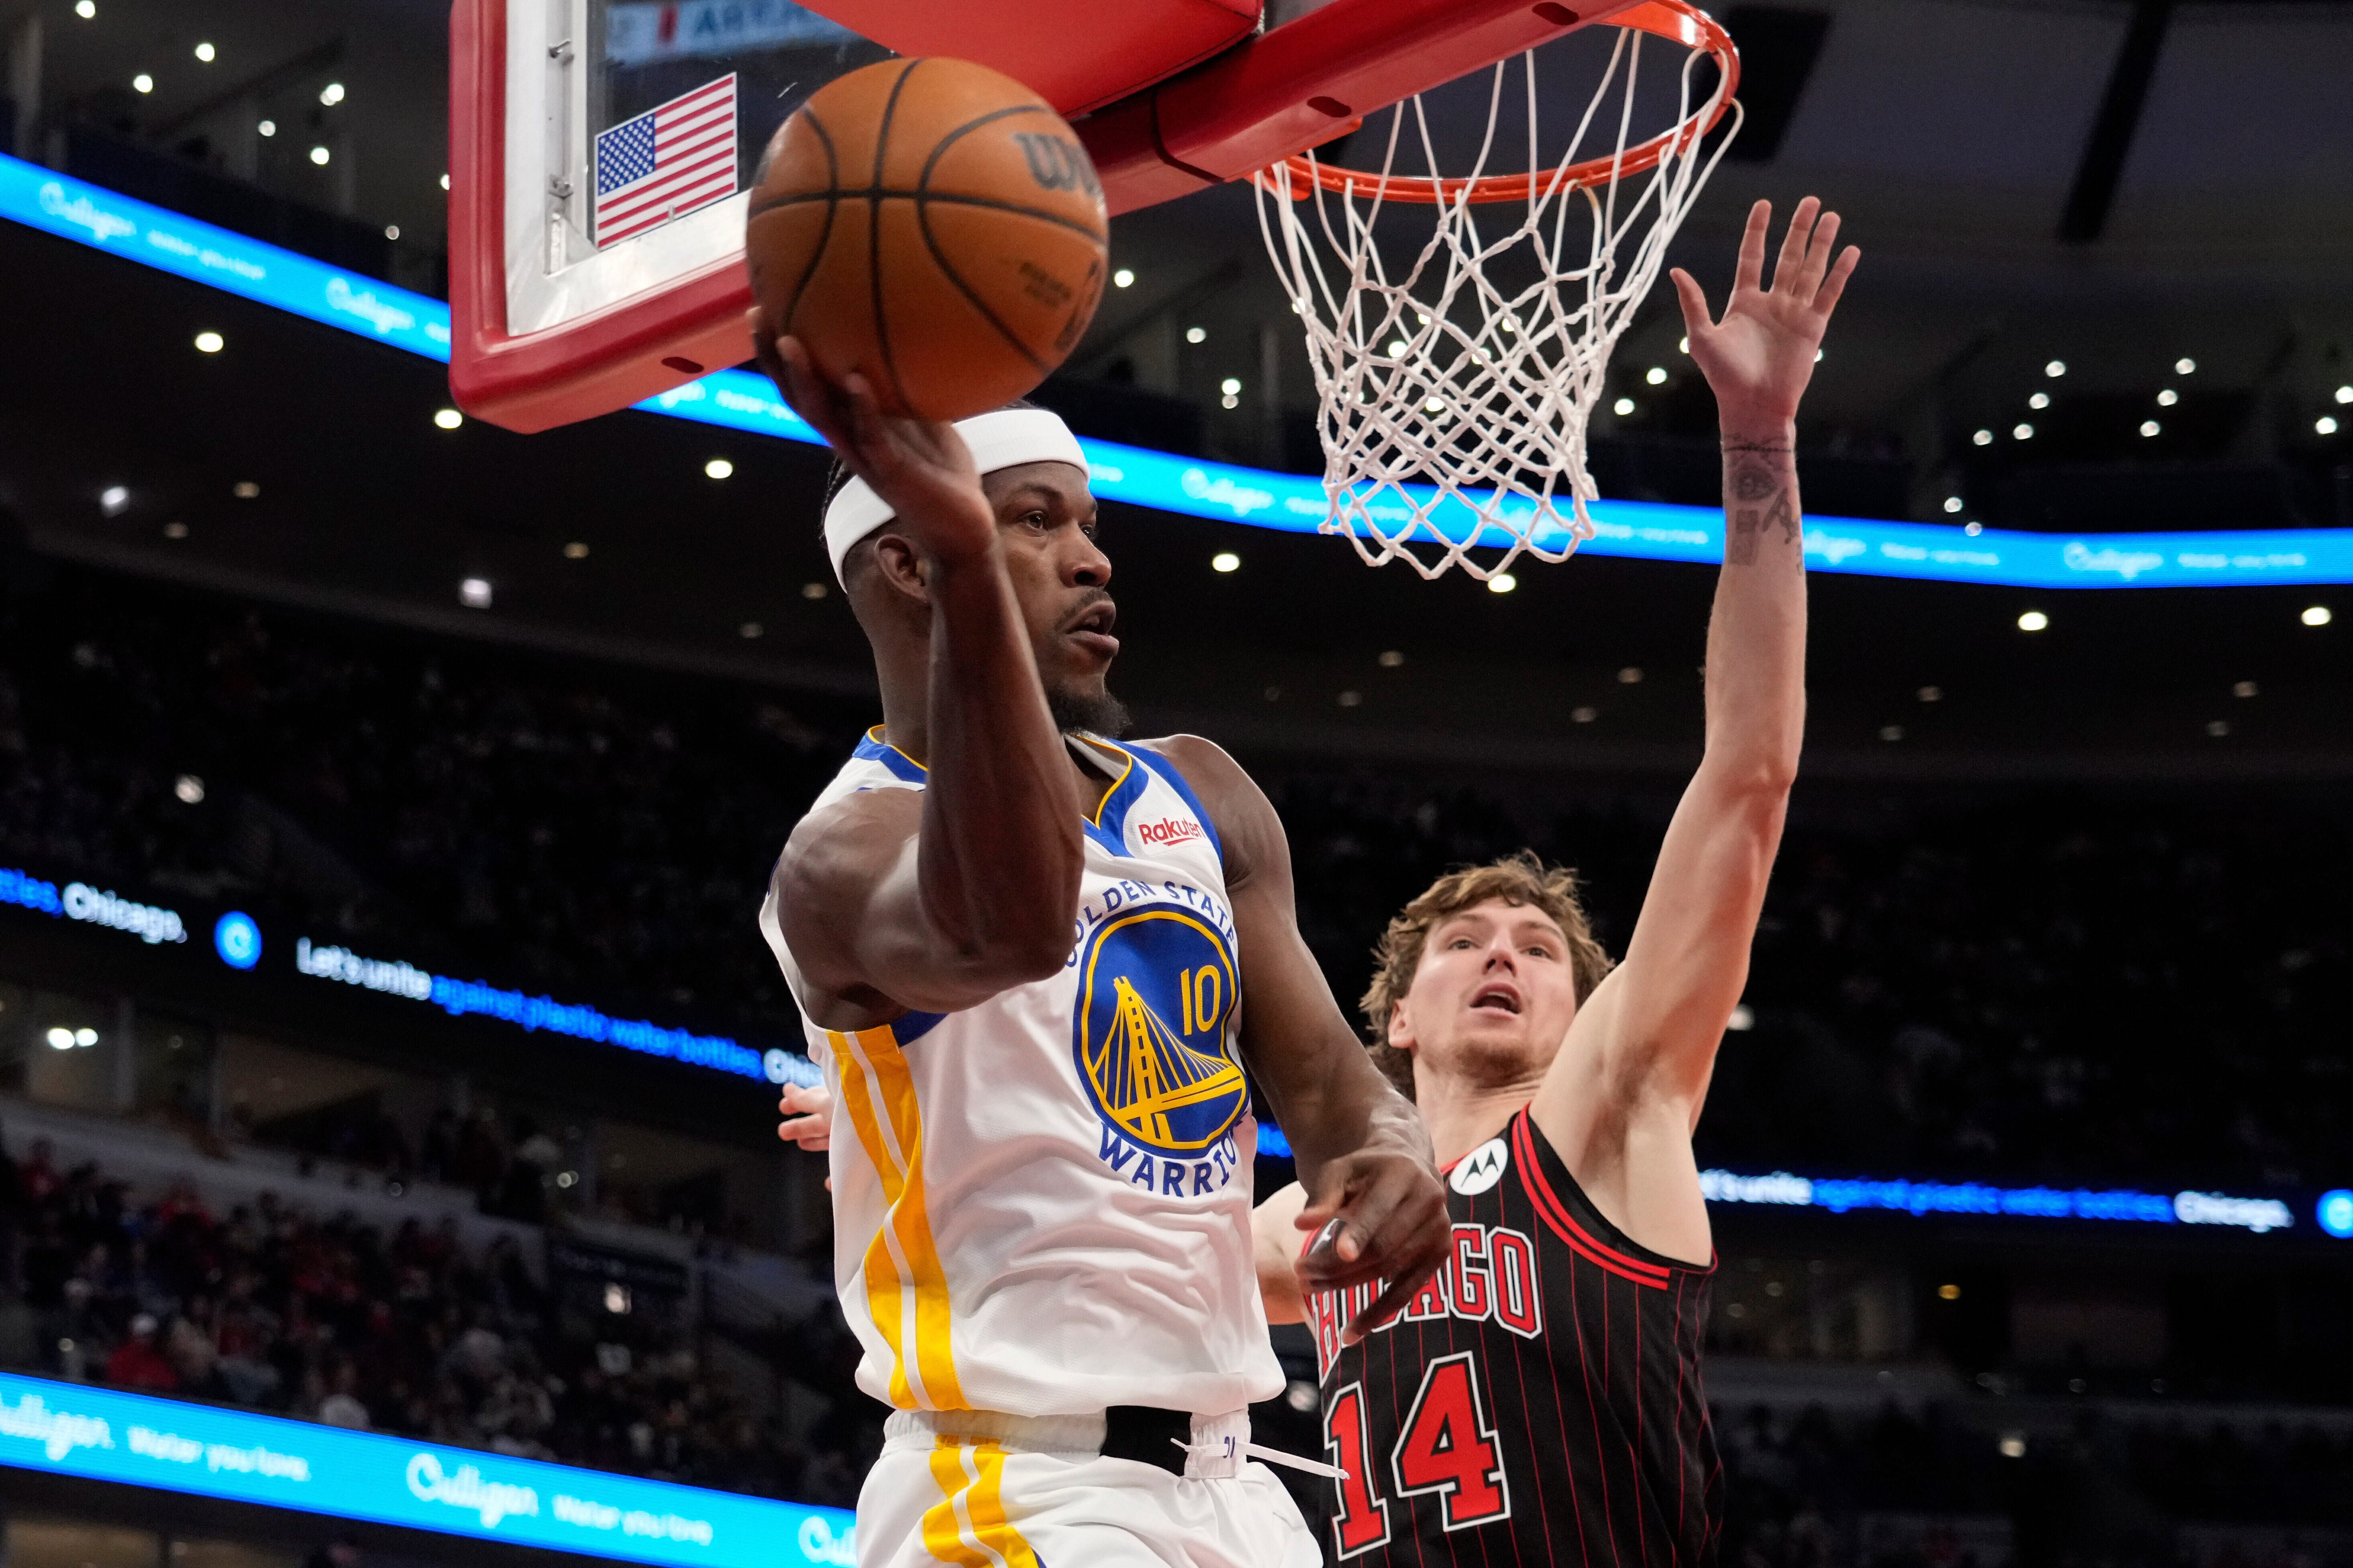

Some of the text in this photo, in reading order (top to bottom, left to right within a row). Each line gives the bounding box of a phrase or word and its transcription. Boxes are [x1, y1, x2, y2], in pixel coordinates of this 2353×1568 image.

[1138, 817, 1206, 845] Rakuten
[1181, 965, 1221, 1036] 10
[1323, 1350, 1511, 1562] 14
